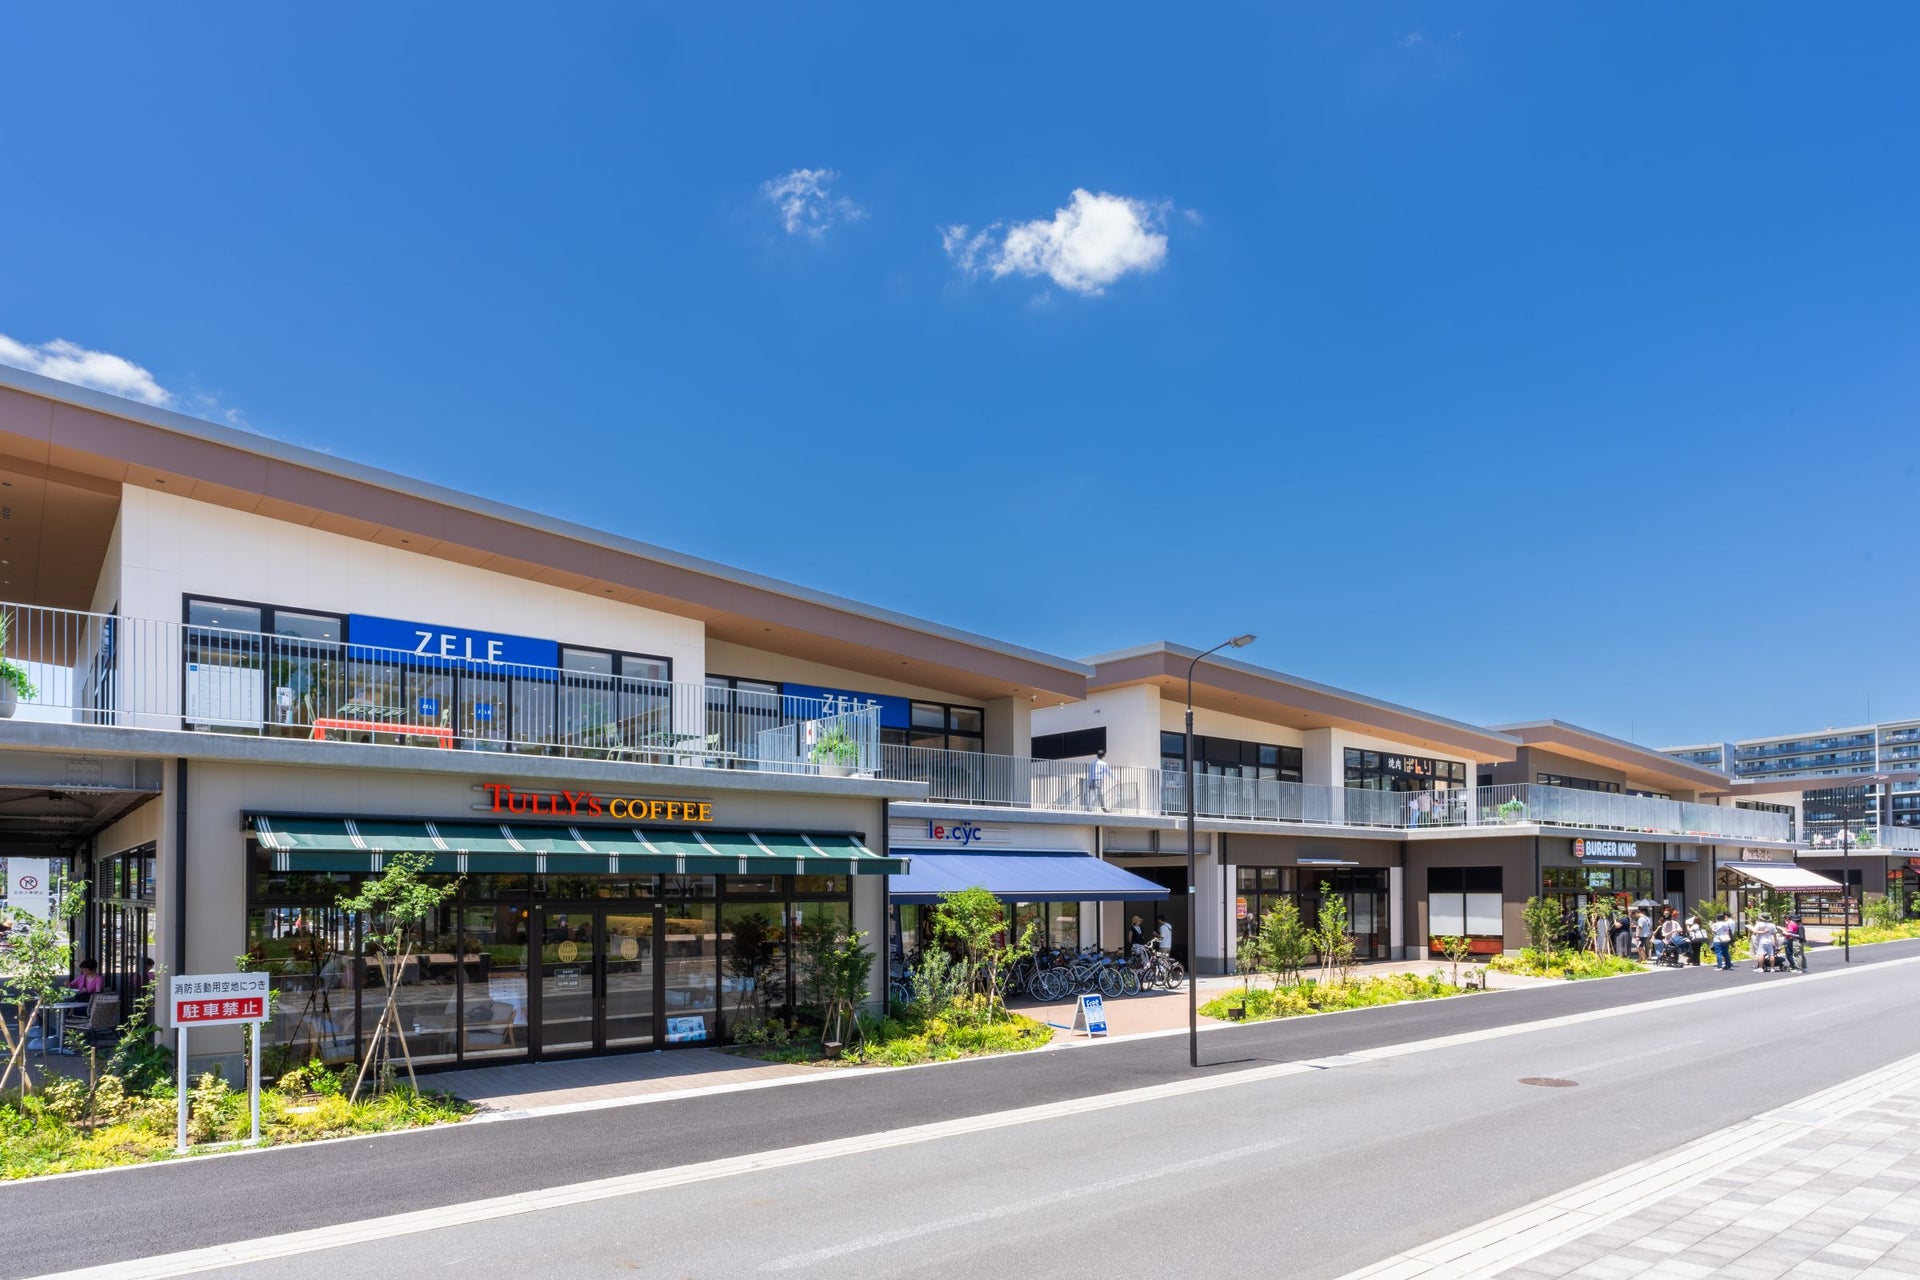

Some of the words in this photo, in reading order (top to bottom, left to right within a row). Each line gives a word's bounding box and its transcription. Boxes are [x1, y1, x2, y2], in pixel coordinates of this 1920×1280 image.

[414, 630, 504, 666] ZELE
[483, 783, 602, 817] TULLY'S
[609, 798, 714, 822] COFFEE
[1585, 841, 1617, 857] BURGER
[1617, 842, 1637, 858] KING
[174, 980, 266, 995] 消防活動用空地につき
[182, 1000, 259, 1019] 駐車禁止
